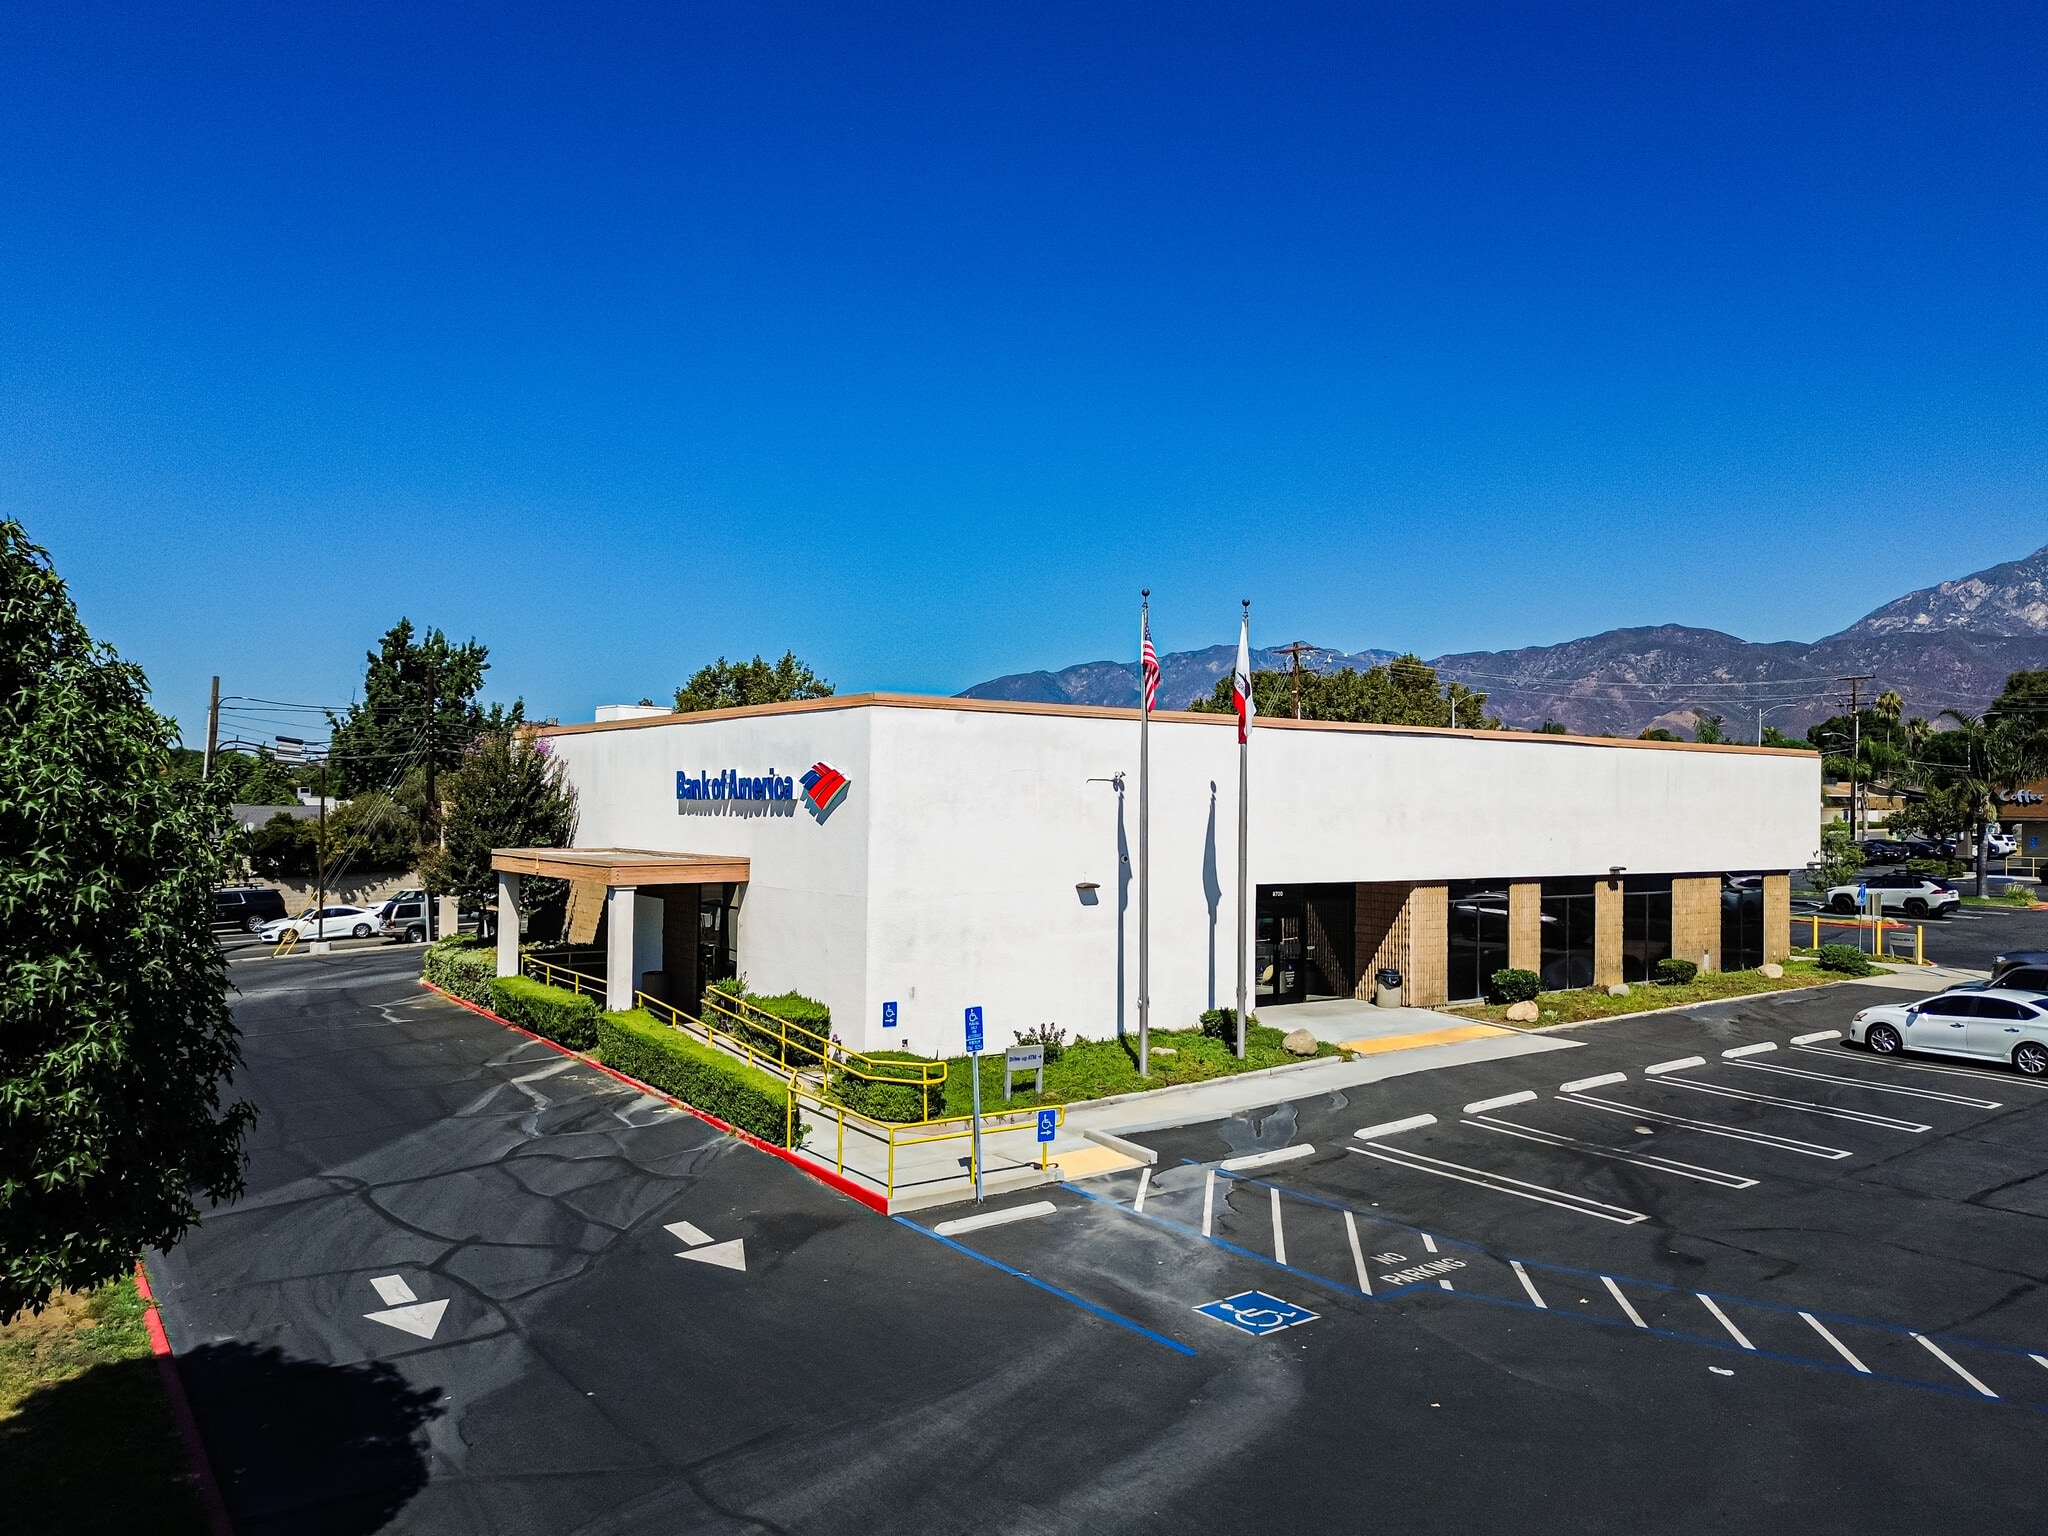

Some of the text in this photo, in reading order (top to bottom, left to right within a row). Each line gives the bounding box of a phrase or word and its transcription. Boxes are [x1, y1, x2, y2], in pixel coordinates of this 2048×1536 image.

[677, 768, 793, 800] Bank of America
[2000, 788, 2045, 803] Coffee
[1370, 1252, 1408, 1265] NO
[1379, 1256, 1468, 1286] PARKING
